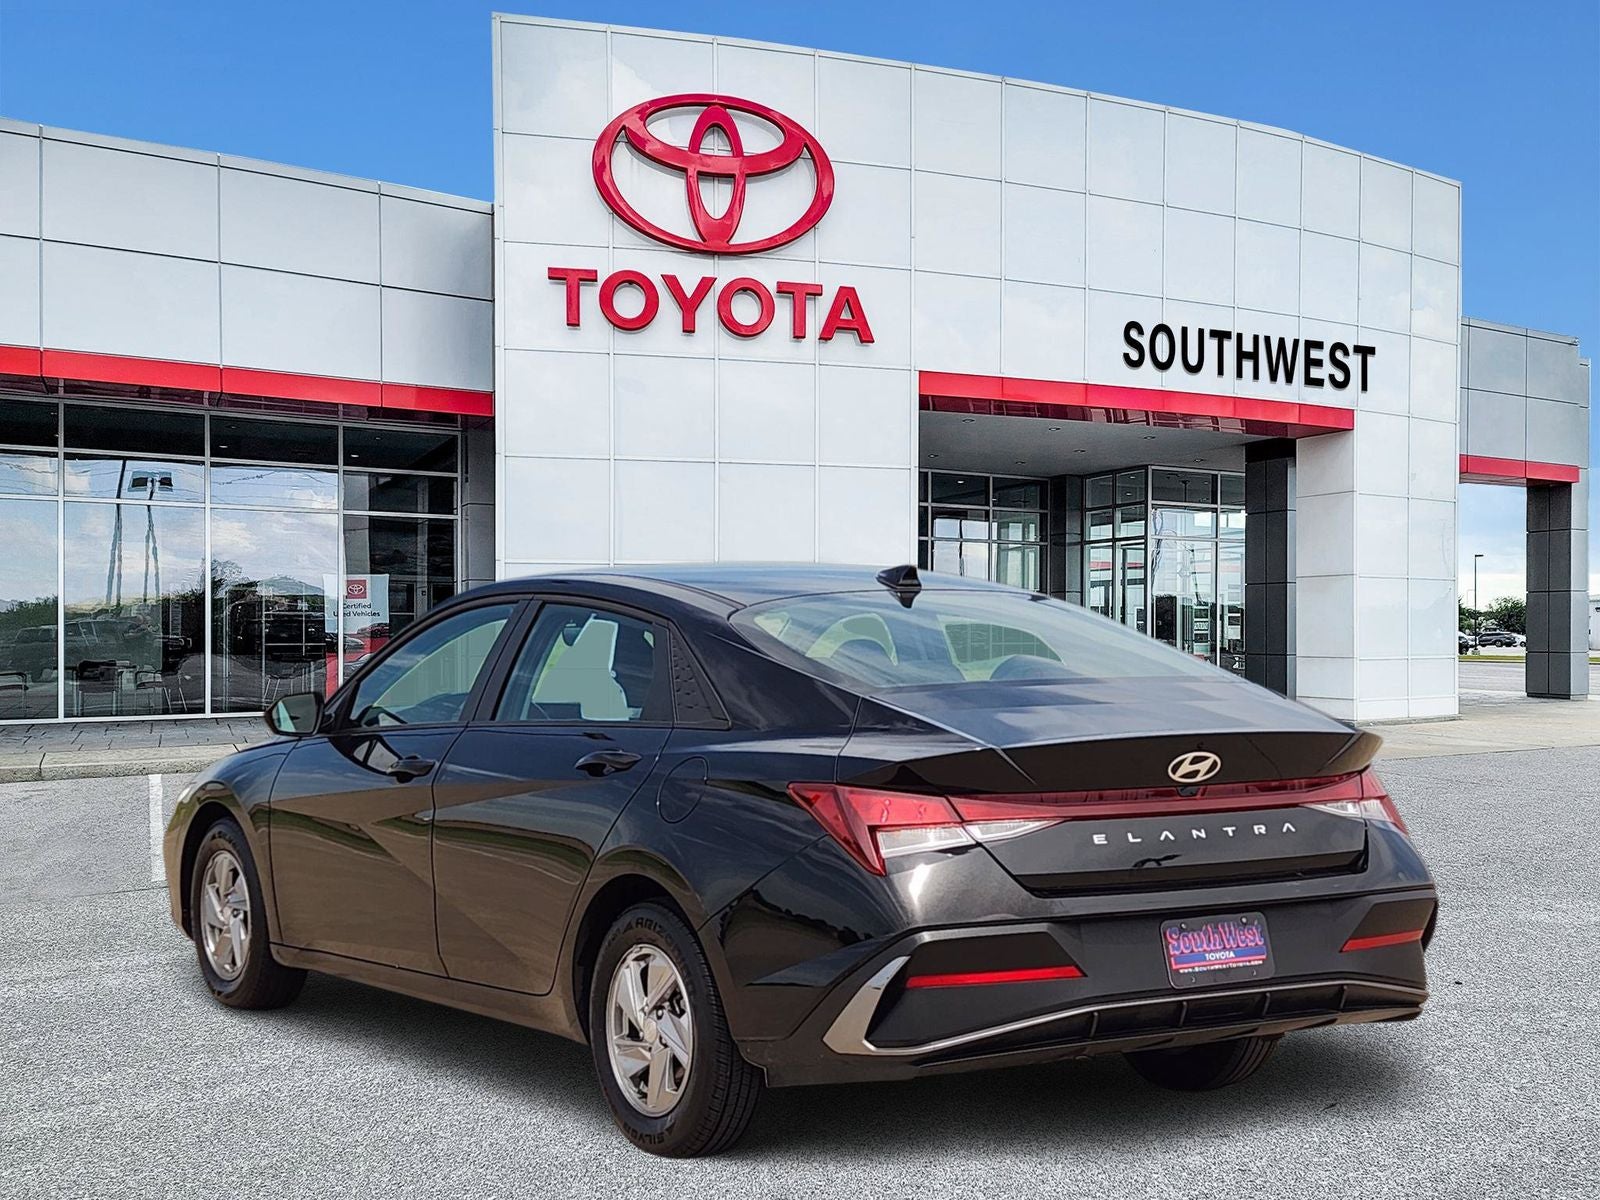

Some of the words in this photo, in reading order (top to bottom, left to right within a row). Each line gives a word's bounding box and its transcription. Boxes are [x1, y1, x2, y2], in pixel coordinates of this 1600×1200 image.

[547, 266, 875, 345] TOYOTA
[1122, 320, 1376, 392] SOUTHWEST
[1092, 822, 1296, 845] ELANTRA
[1166, 919, 1265, 955] SouthWest
[1205, 950, 1236, 961] TOYOTA
